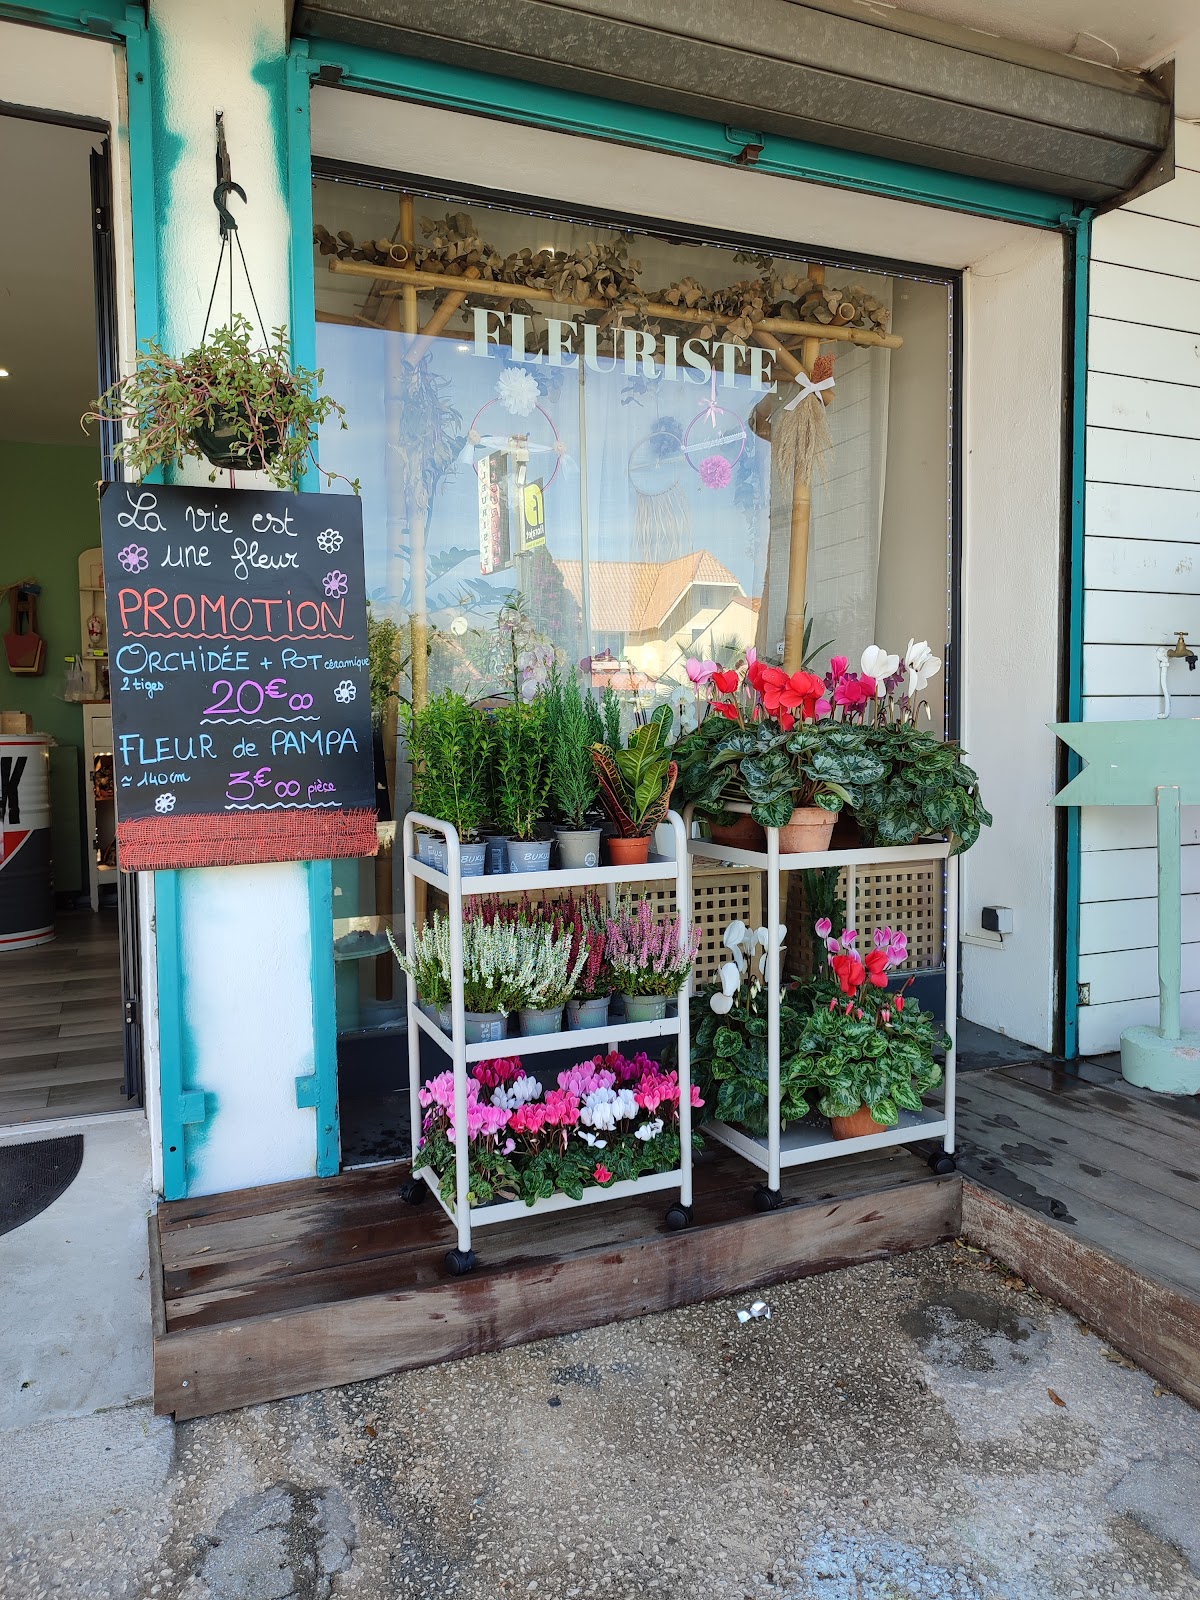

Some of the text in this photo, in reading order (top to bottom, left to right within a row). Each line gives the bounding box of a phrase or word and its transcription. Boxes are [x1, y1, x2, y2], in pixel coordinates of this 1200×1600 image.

[471, 307, 778, 394] FLEURISTE
[117, 490, 298, 537] La vie est
[160, 537, 300, 581] une fleur
[281, 648, 323, 670] POT
[324, 656, 370, 673] céramique
[120, 676, 164, 699] 2 tiges
[118, 727, 359, 766] FLEUR de PAMPA
[307, 778, 337, 801] pièce
[460, 854, 486, 864] BUXU
